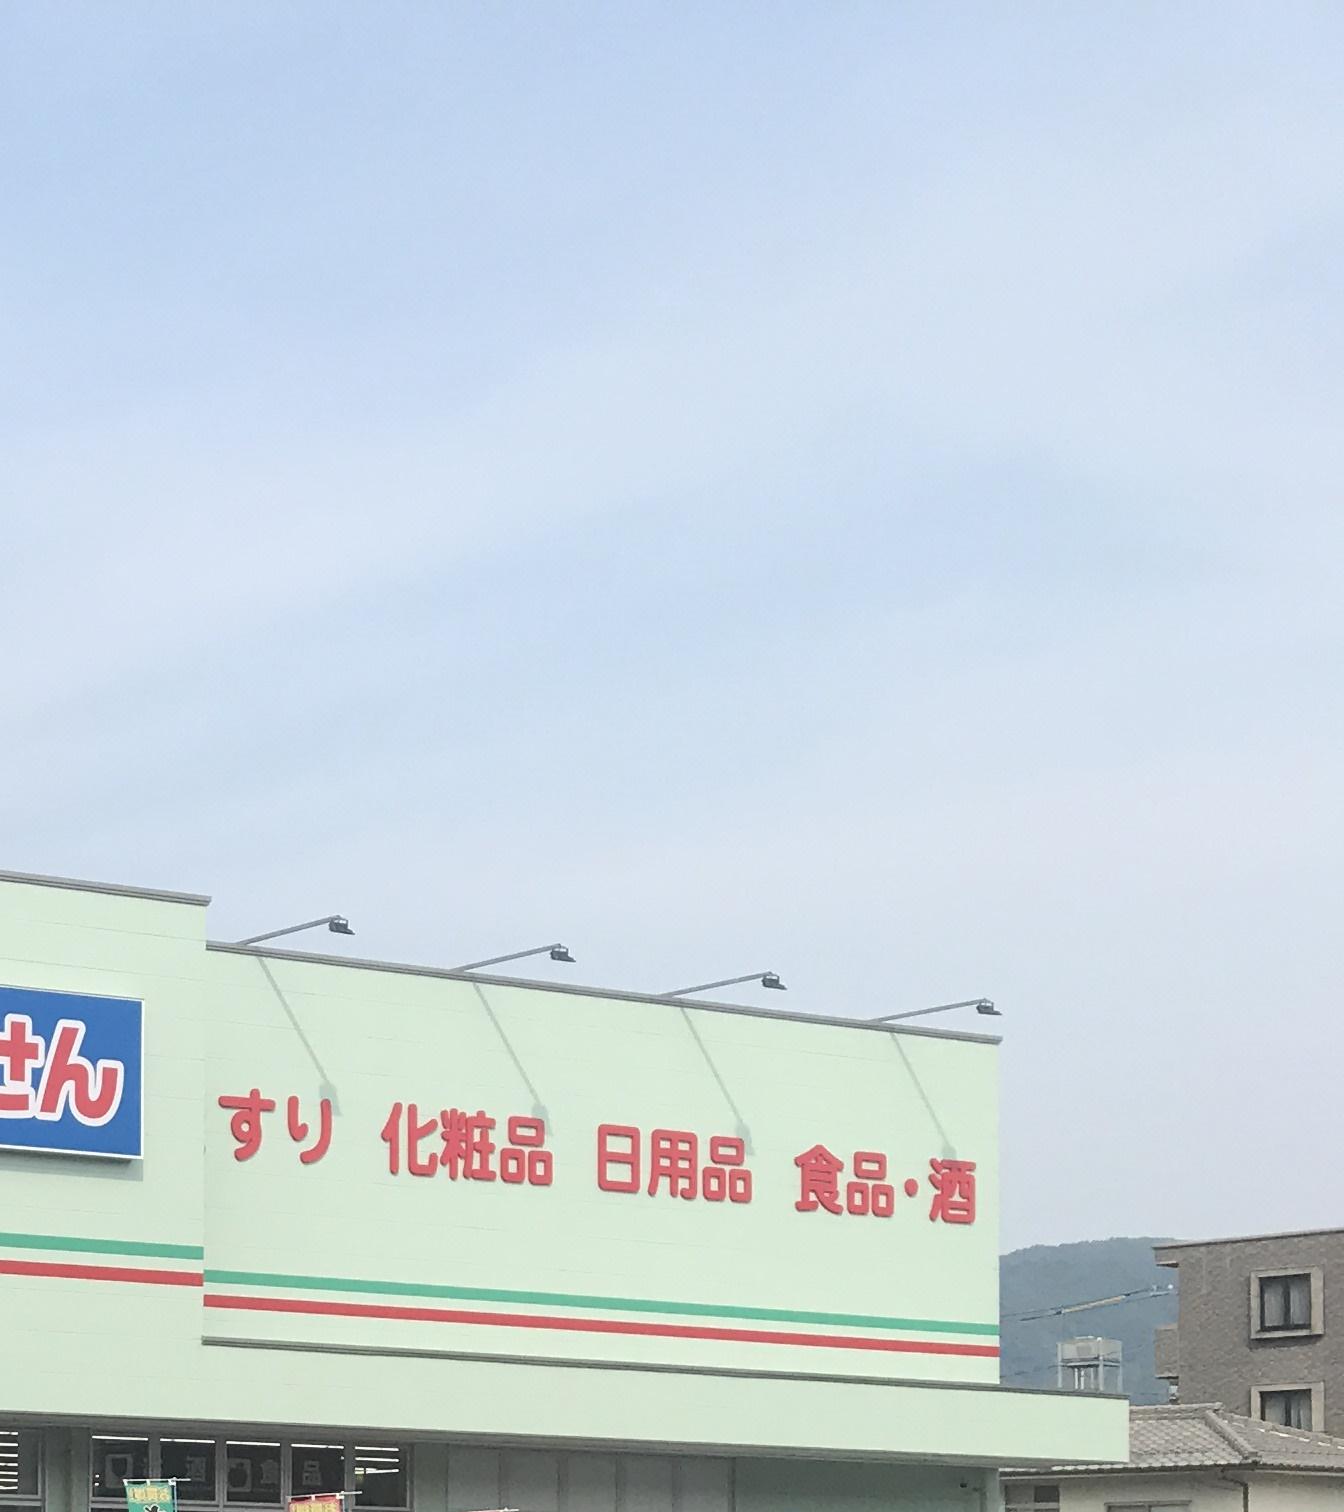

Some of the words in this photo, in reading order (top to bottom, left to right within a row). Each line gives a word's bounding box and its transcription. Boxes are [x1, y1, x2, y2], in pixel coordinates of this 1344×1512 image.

[381, 1101, 554, 1187] 化粧品
[596, 1123, 753, 1204] 日用品
[793, 1143, 977, 1225] 食品・酒
